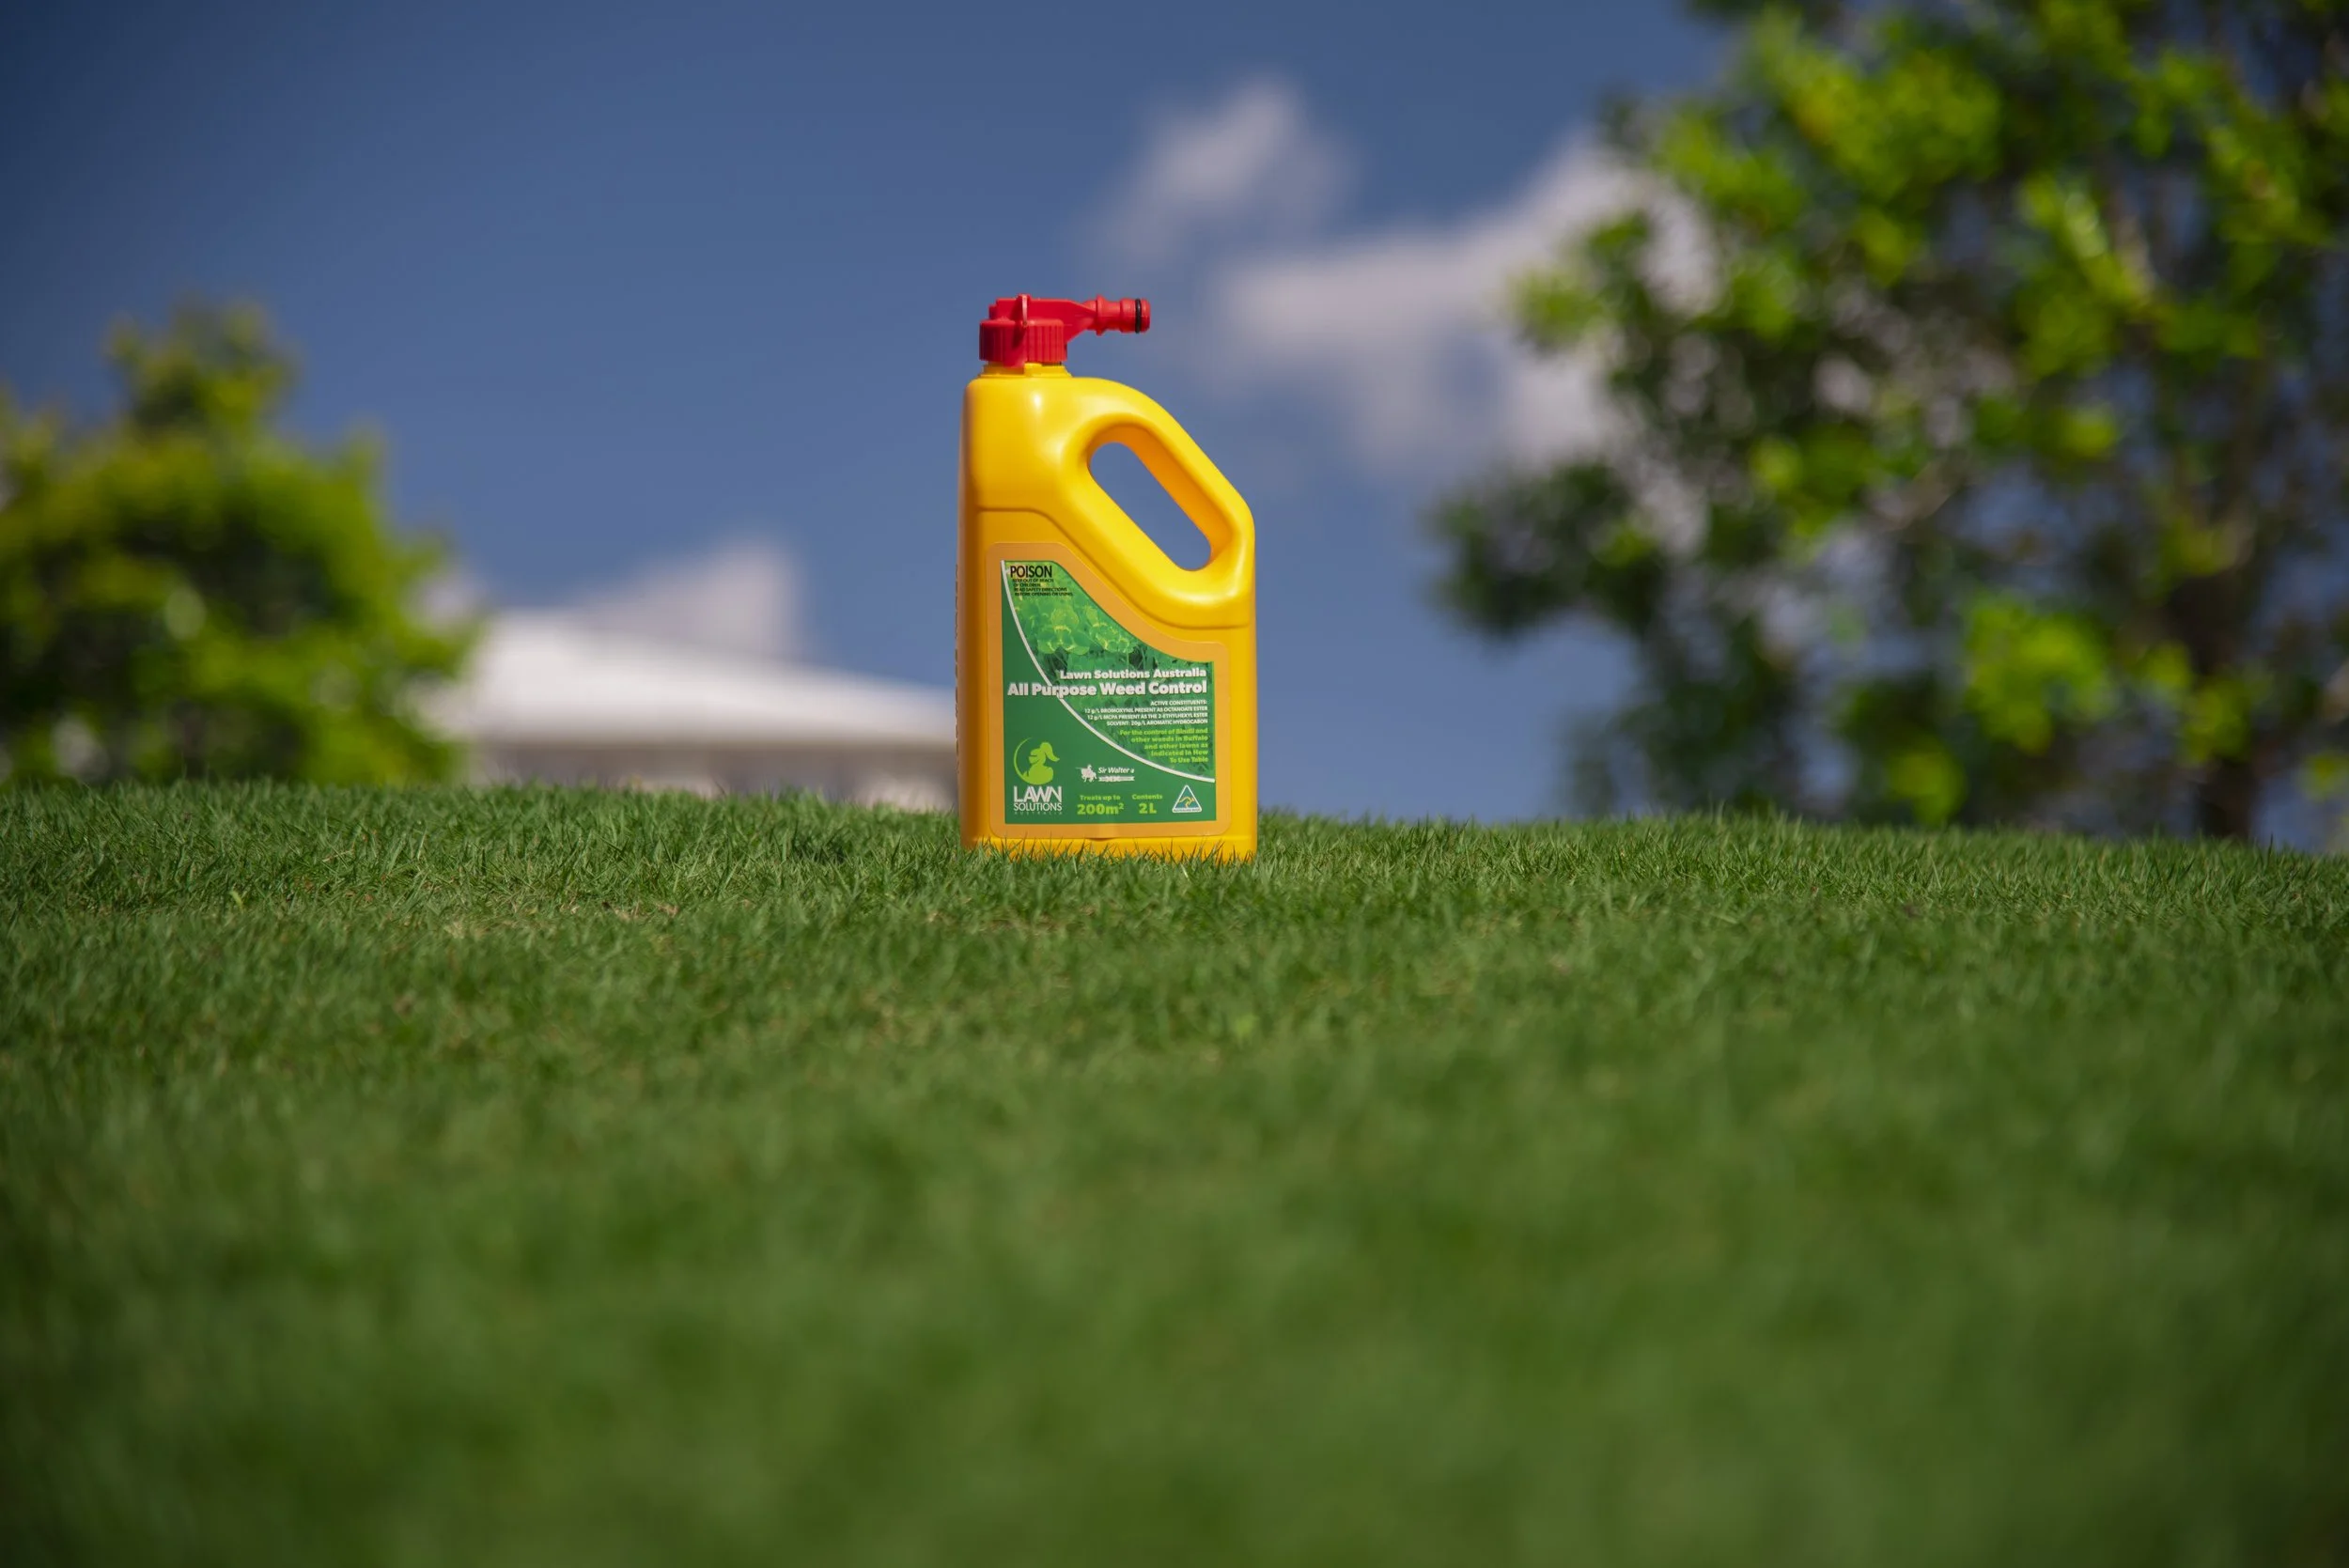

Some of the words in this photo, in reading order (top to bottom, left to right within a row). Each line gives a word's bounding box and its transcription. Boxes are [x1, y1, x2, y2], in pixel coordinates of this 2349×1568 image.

[1010, 565, 1052, 578] POISON
[1060, 670, 1092, 680] Lawn
[1094, 669, 1150, 679] Solutions
[1152, 667, 1207, 678] Australia
[1007, 682, 1029, 696] All
[1032, 682, 1097, 699] Purpose
[1098, 681, 1146, 695] Weed
[1148, 679, 1207, 695] Control
[1014, 785, 1063, 803] LAWN
[1014, 803, 1063, 812] SOLUTIONS
